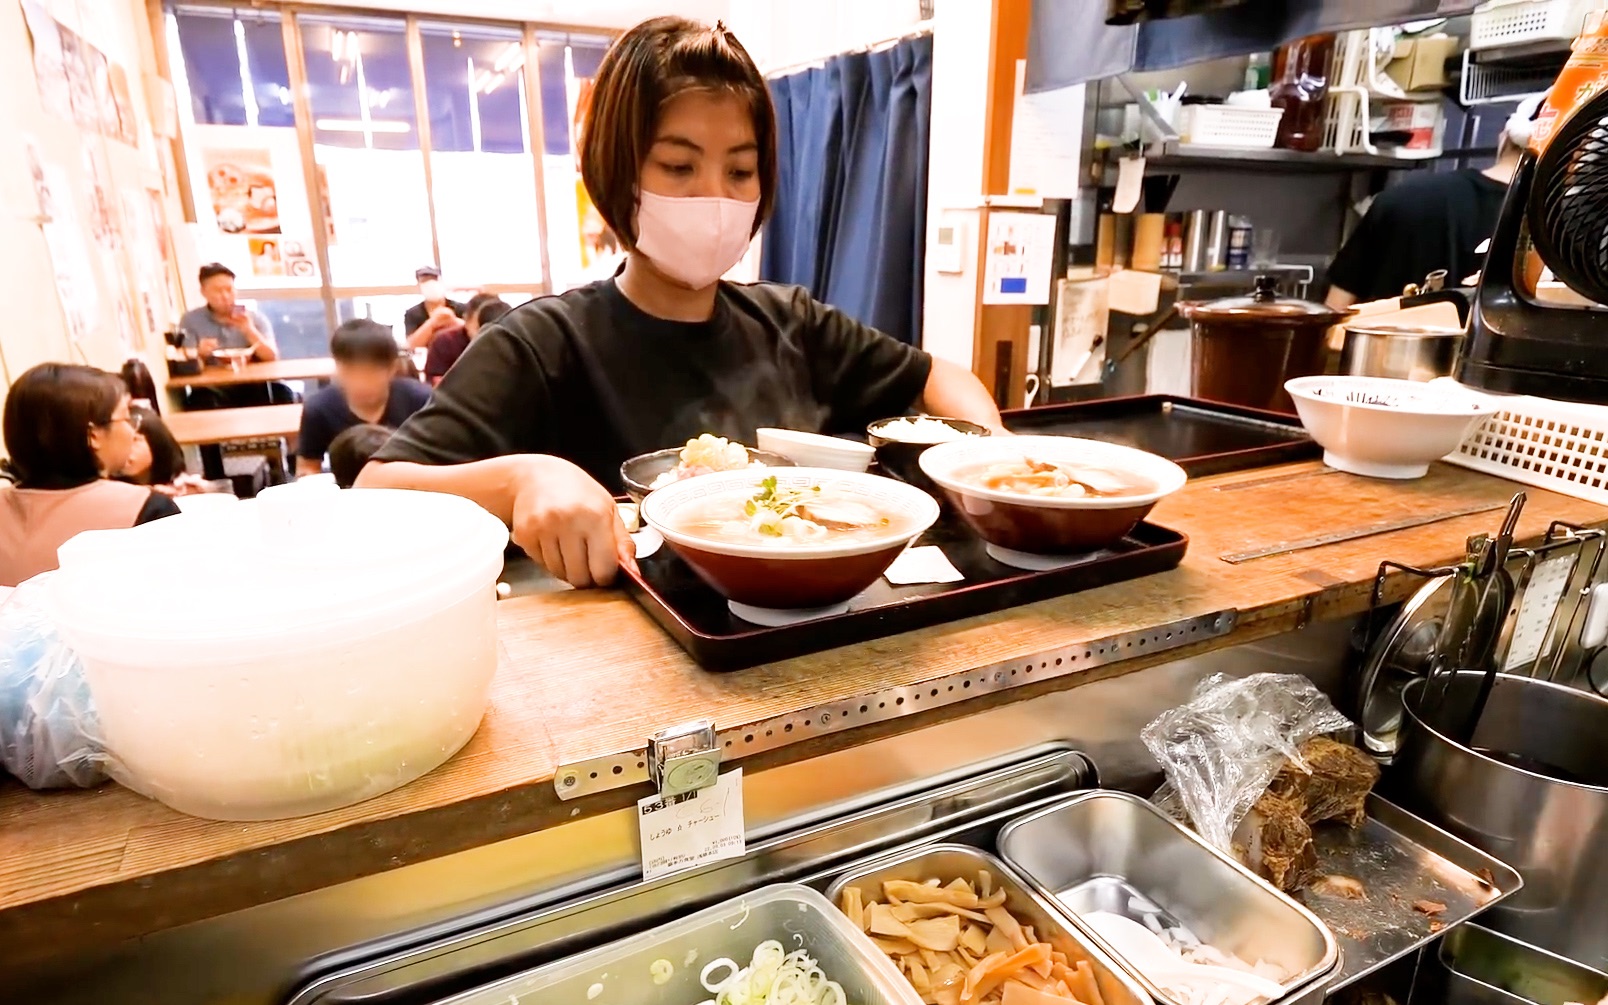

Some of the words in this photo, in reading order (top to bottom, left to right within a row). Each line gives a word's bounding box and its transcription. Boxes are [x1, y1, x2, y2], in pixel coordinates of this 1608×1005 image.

[643, 796, 676, 814] 53番
[650, 828, 672, 841] しょうゆ
[688, 815, 720, 828] チャーシュー
